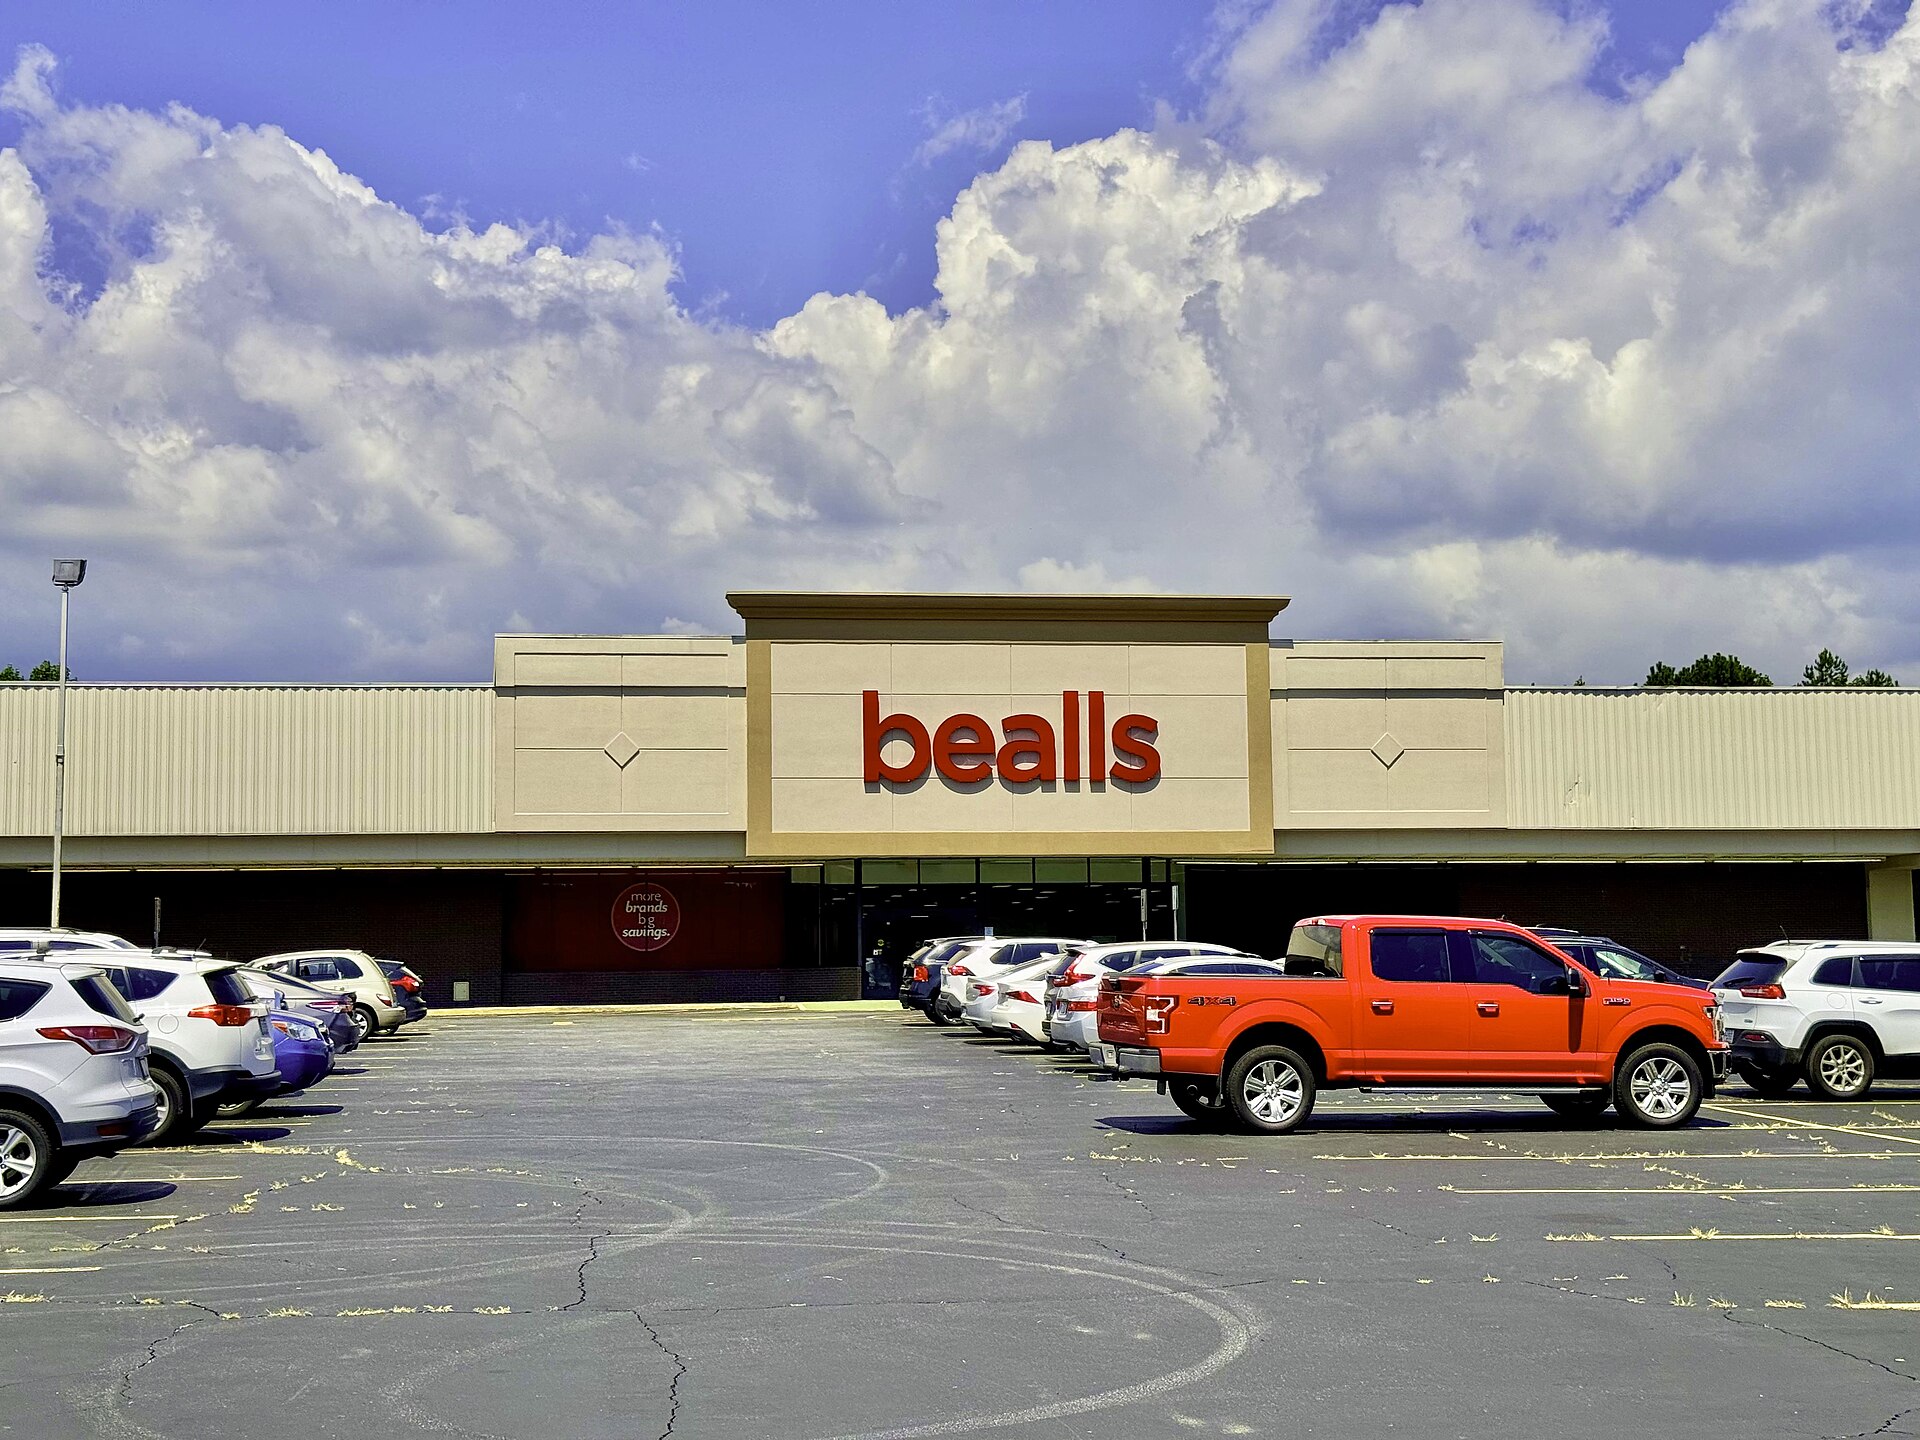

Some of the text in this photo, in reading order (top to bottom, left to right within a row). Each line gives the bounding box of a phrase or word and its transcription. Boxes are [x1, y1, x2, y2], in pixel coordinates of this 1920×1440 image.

[862, 689, 1161, 790] bealls
[631, 893, 662, 901] more
[625, 900, 668, 913] brands
[638, 913, 656, 929] bg
[622, 927, 671, 940] savings.
